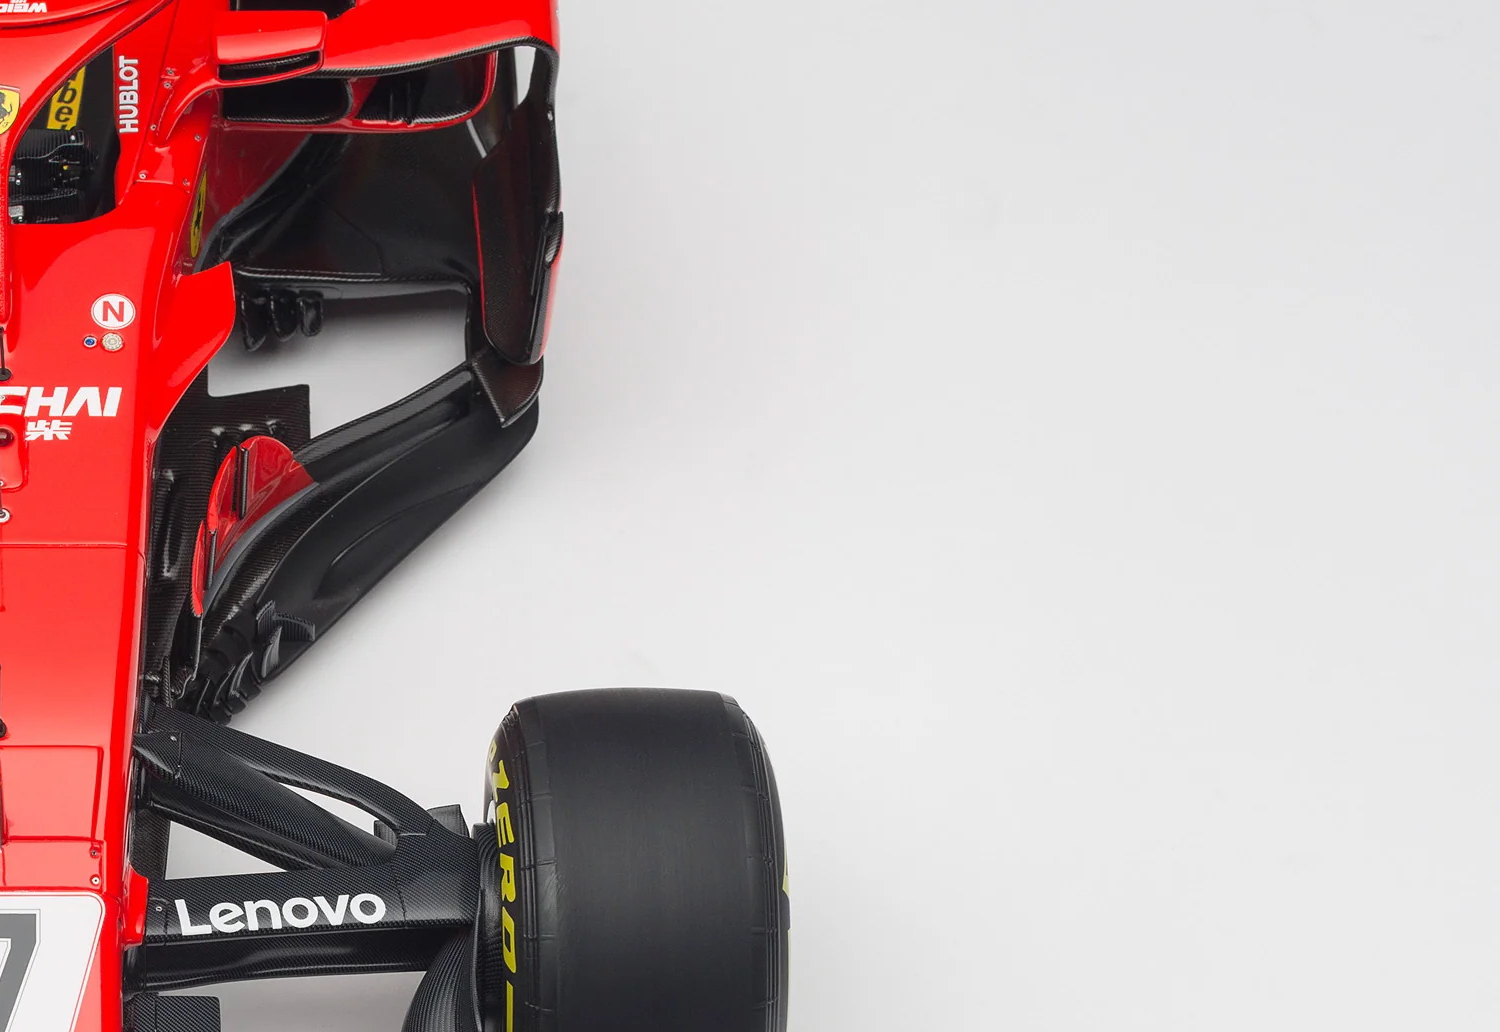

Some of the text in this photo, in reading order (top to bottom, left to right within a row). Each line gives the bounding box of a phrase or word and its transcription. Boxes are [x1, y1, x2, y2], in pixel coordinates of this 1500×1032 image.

[118, 55, 139, 133] HUBLOT
[102, 301, 125, 322] N
[492, 760, 517, 974] ZERO
[174, 893, 386, 936] Lenovo
